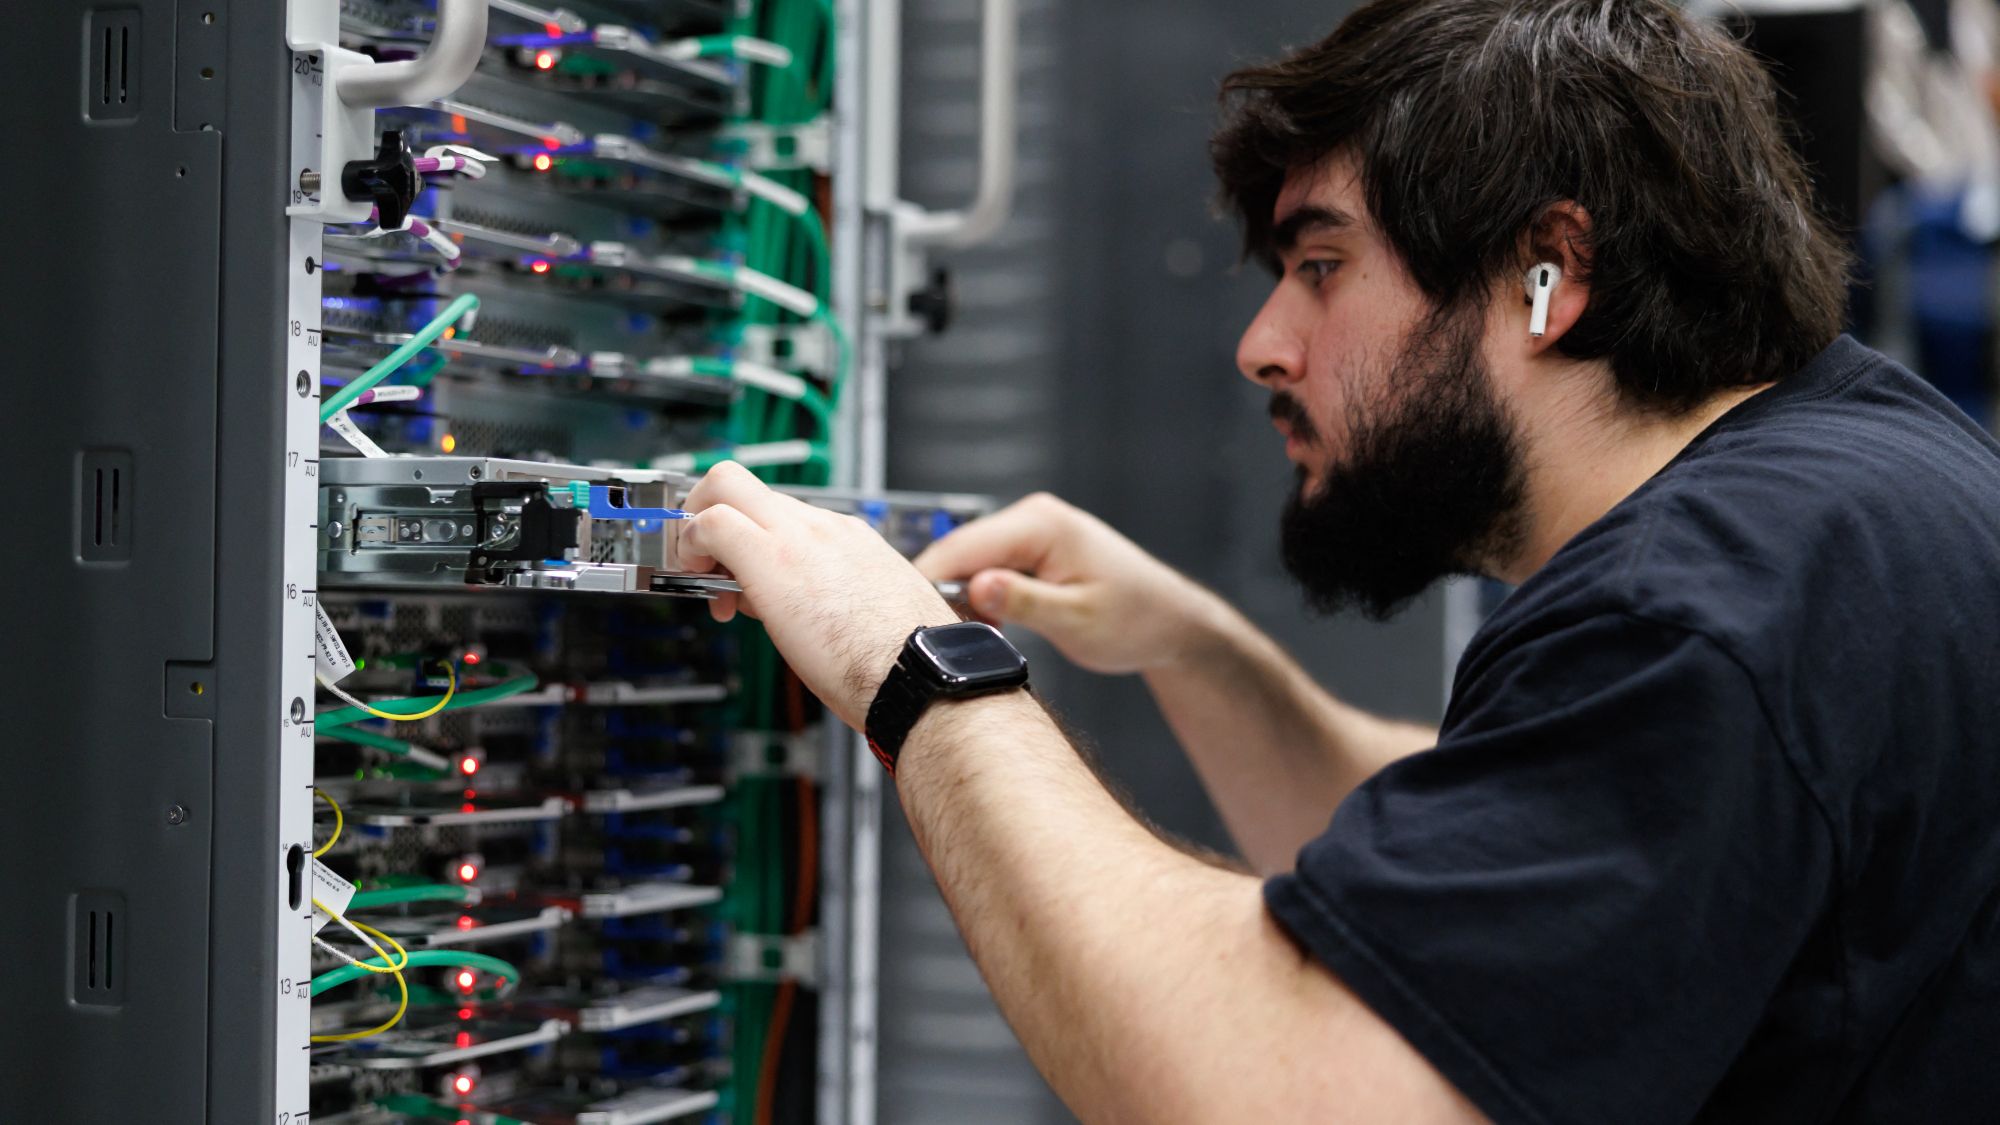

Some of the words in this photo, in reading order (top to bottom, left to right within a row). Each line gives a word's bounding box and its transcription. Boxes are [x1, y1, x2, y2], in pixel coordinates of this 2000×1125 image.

[295, 57, 309, 75] 20
[293, 190, 301, 204] 19
[291, 320, 301, 336] 18
[308, 335, 318, 347] AU
[288, 451, 298, 468] 17
[305, 465, 315, 477] AU
[286, 583, 296, 600] 16
[302, 595, 313, 607] AU
[301, 726, 311, 738] AU
[280, 978, 291, 995] 13
[297, 987, 308, 999] AU
